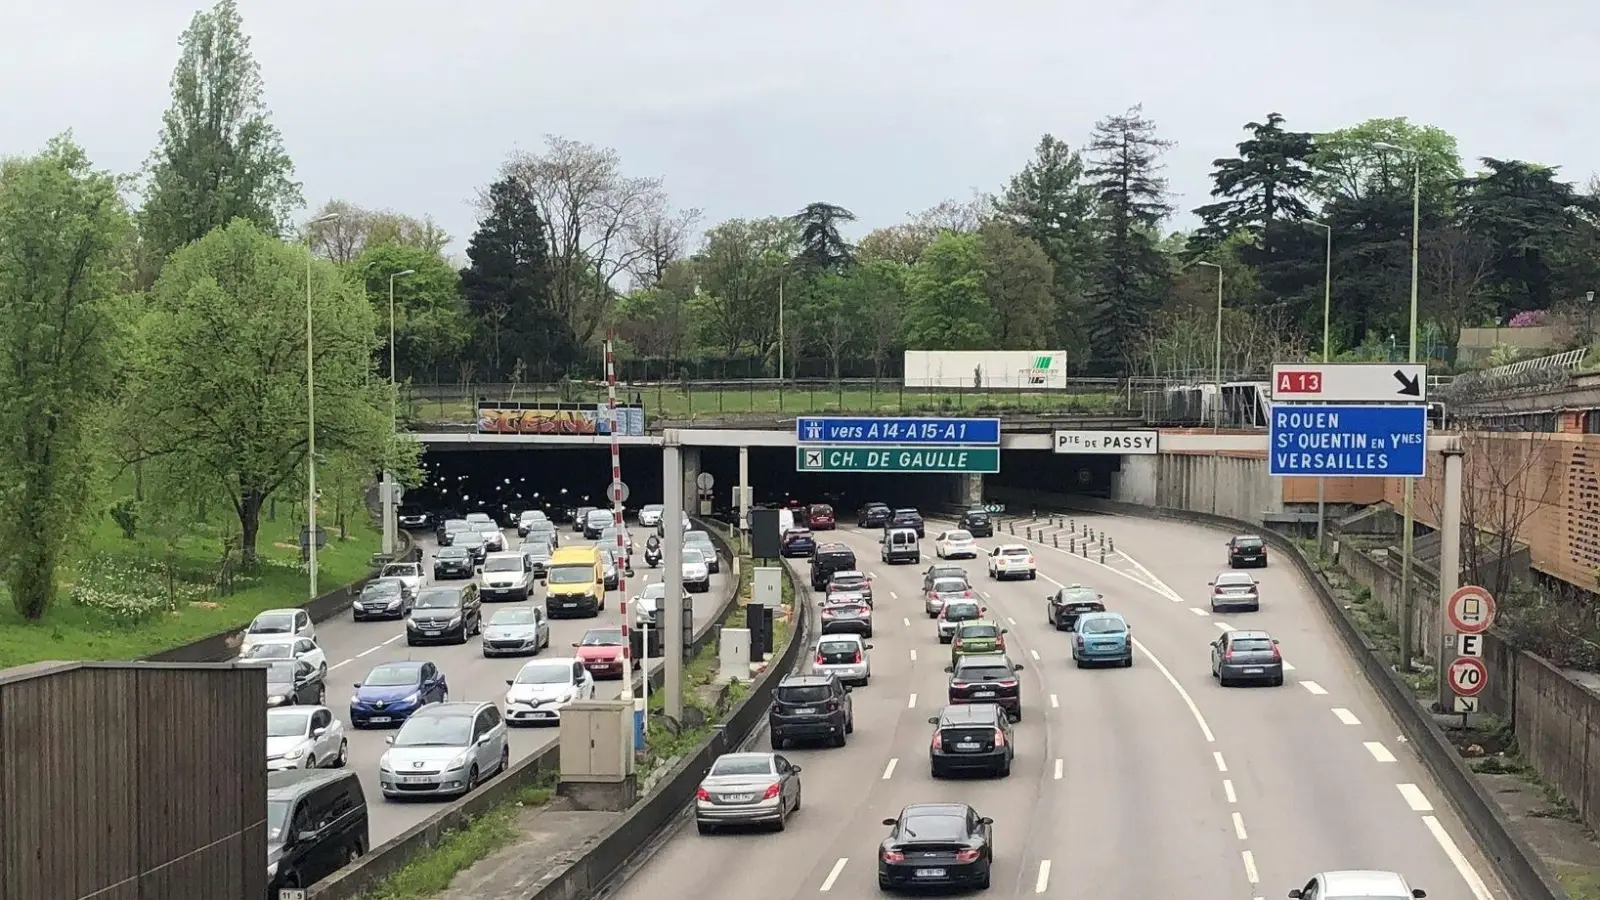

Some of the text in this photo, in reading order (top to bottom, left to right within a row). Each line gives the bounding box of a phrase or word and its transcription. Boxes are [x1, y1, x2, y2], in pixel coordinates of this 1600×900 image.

[1280, 374, 1319, 390] A 13
[1277, 412, 1339, 429] ROUEN
[831, 426, 863, 438] vers
[1084, 440, 1097, 448] DE
[1103, 436, 1153, 448] PASSY
[1298, 433, 1367, 449] QUENTIN
[1371, 438, 1385, 449] EN
[830, 452, 968, 468] CH. DE GAULLE
[1277, 453, 1389, 469] VERSAILLES
[1463, 636, 1477, 655] E
[1458, 669, 1480, 684] 70
